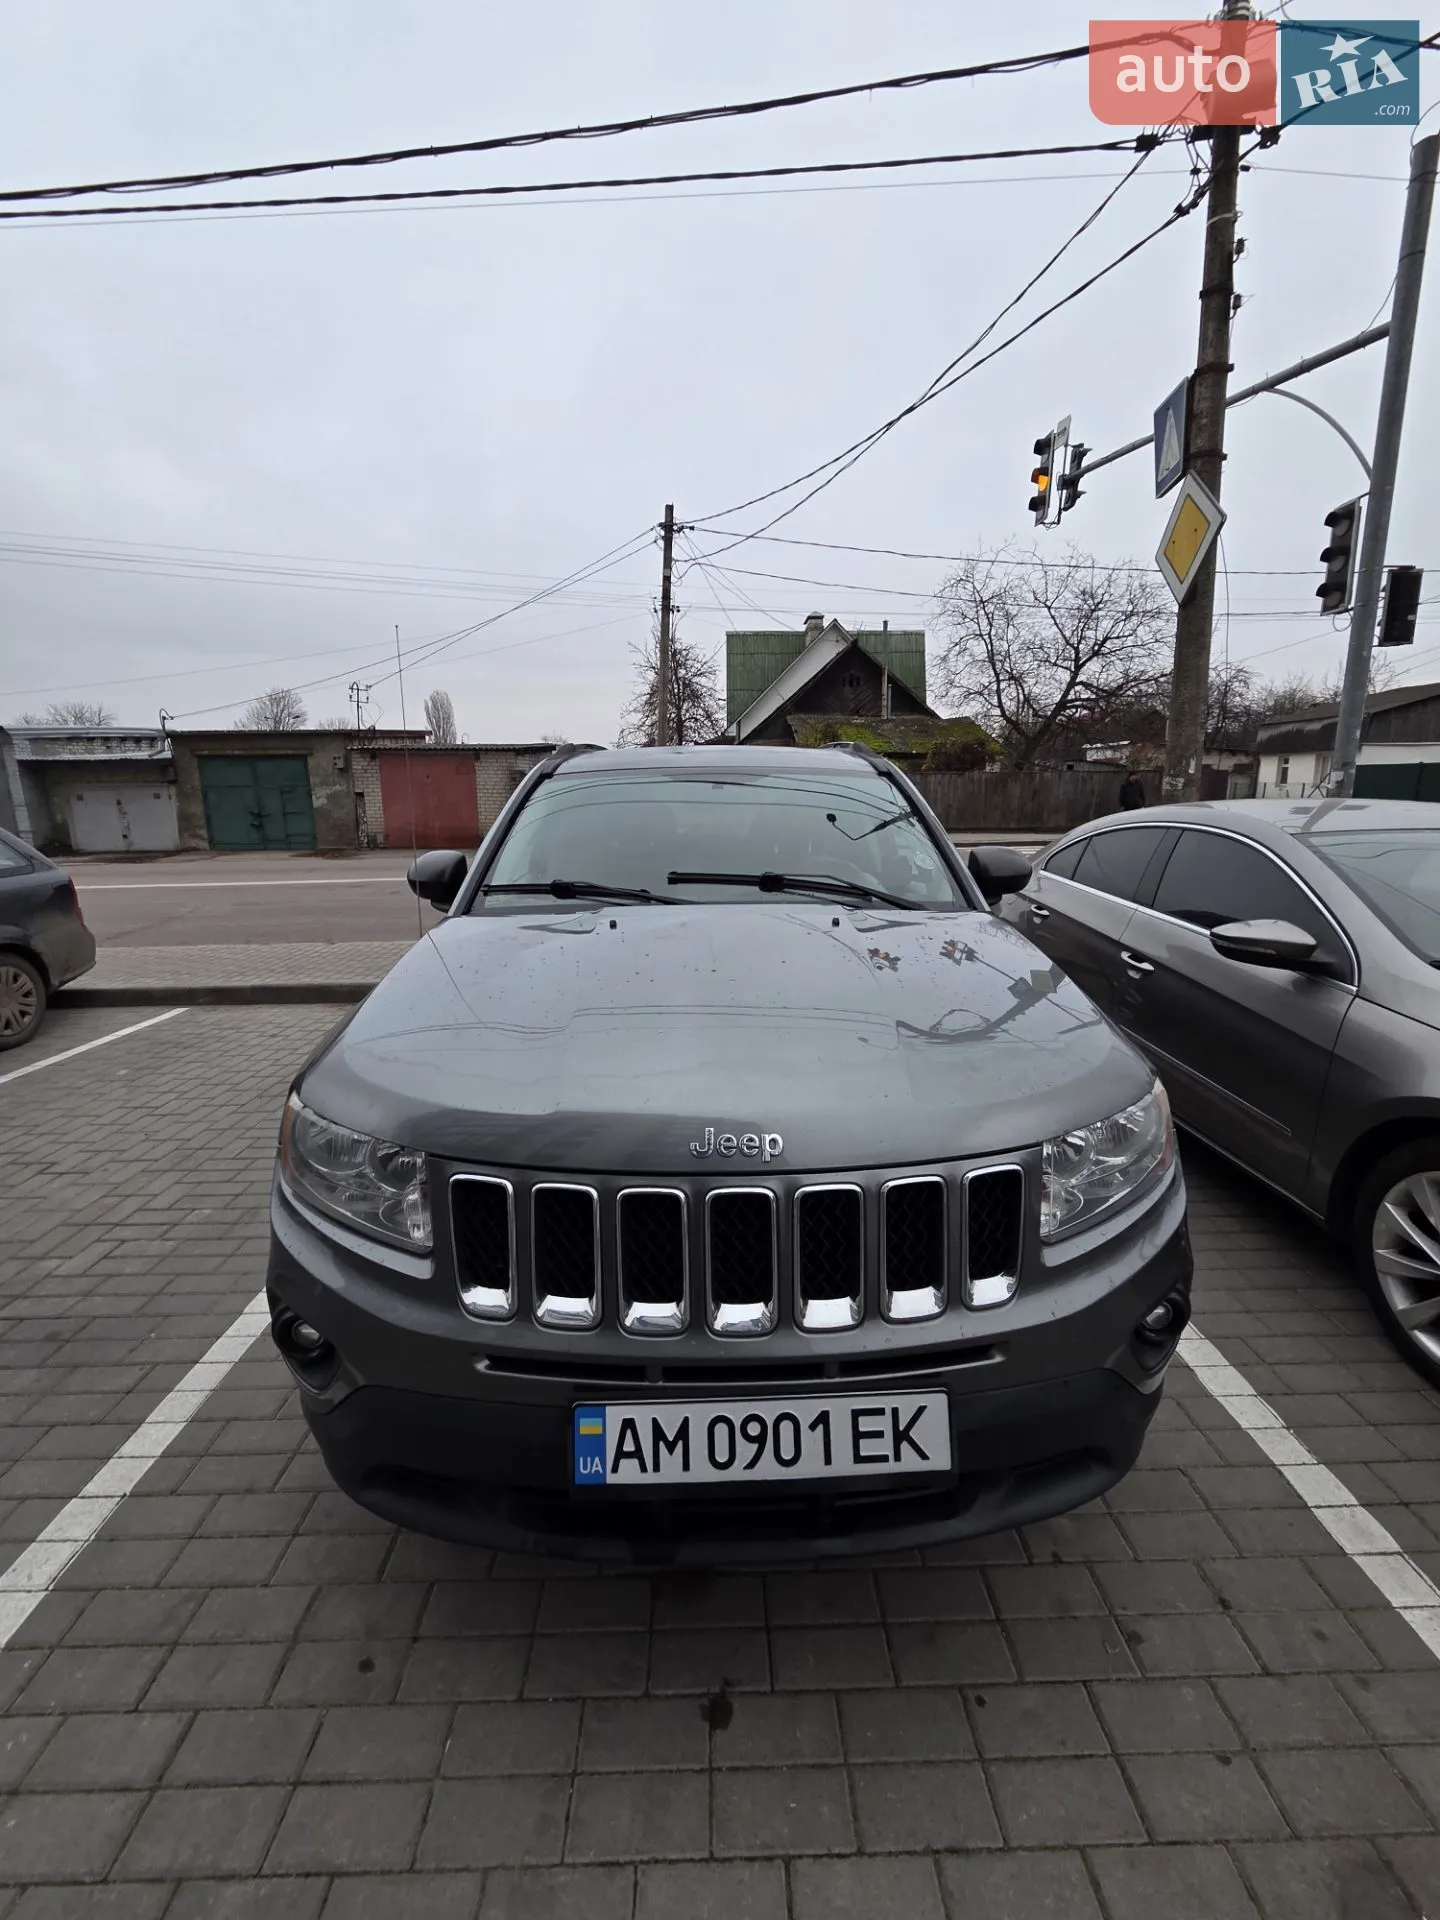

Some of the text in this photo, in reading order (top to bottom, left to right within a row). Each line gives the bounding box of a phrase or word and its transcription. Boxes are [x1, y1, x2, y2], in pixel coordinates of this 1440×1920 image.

[689, 1127, 784, 1163] Jeep
[611, 1404, 930, 1474] AM 0901 EK
[579, 1456, 603, 1474] UA
